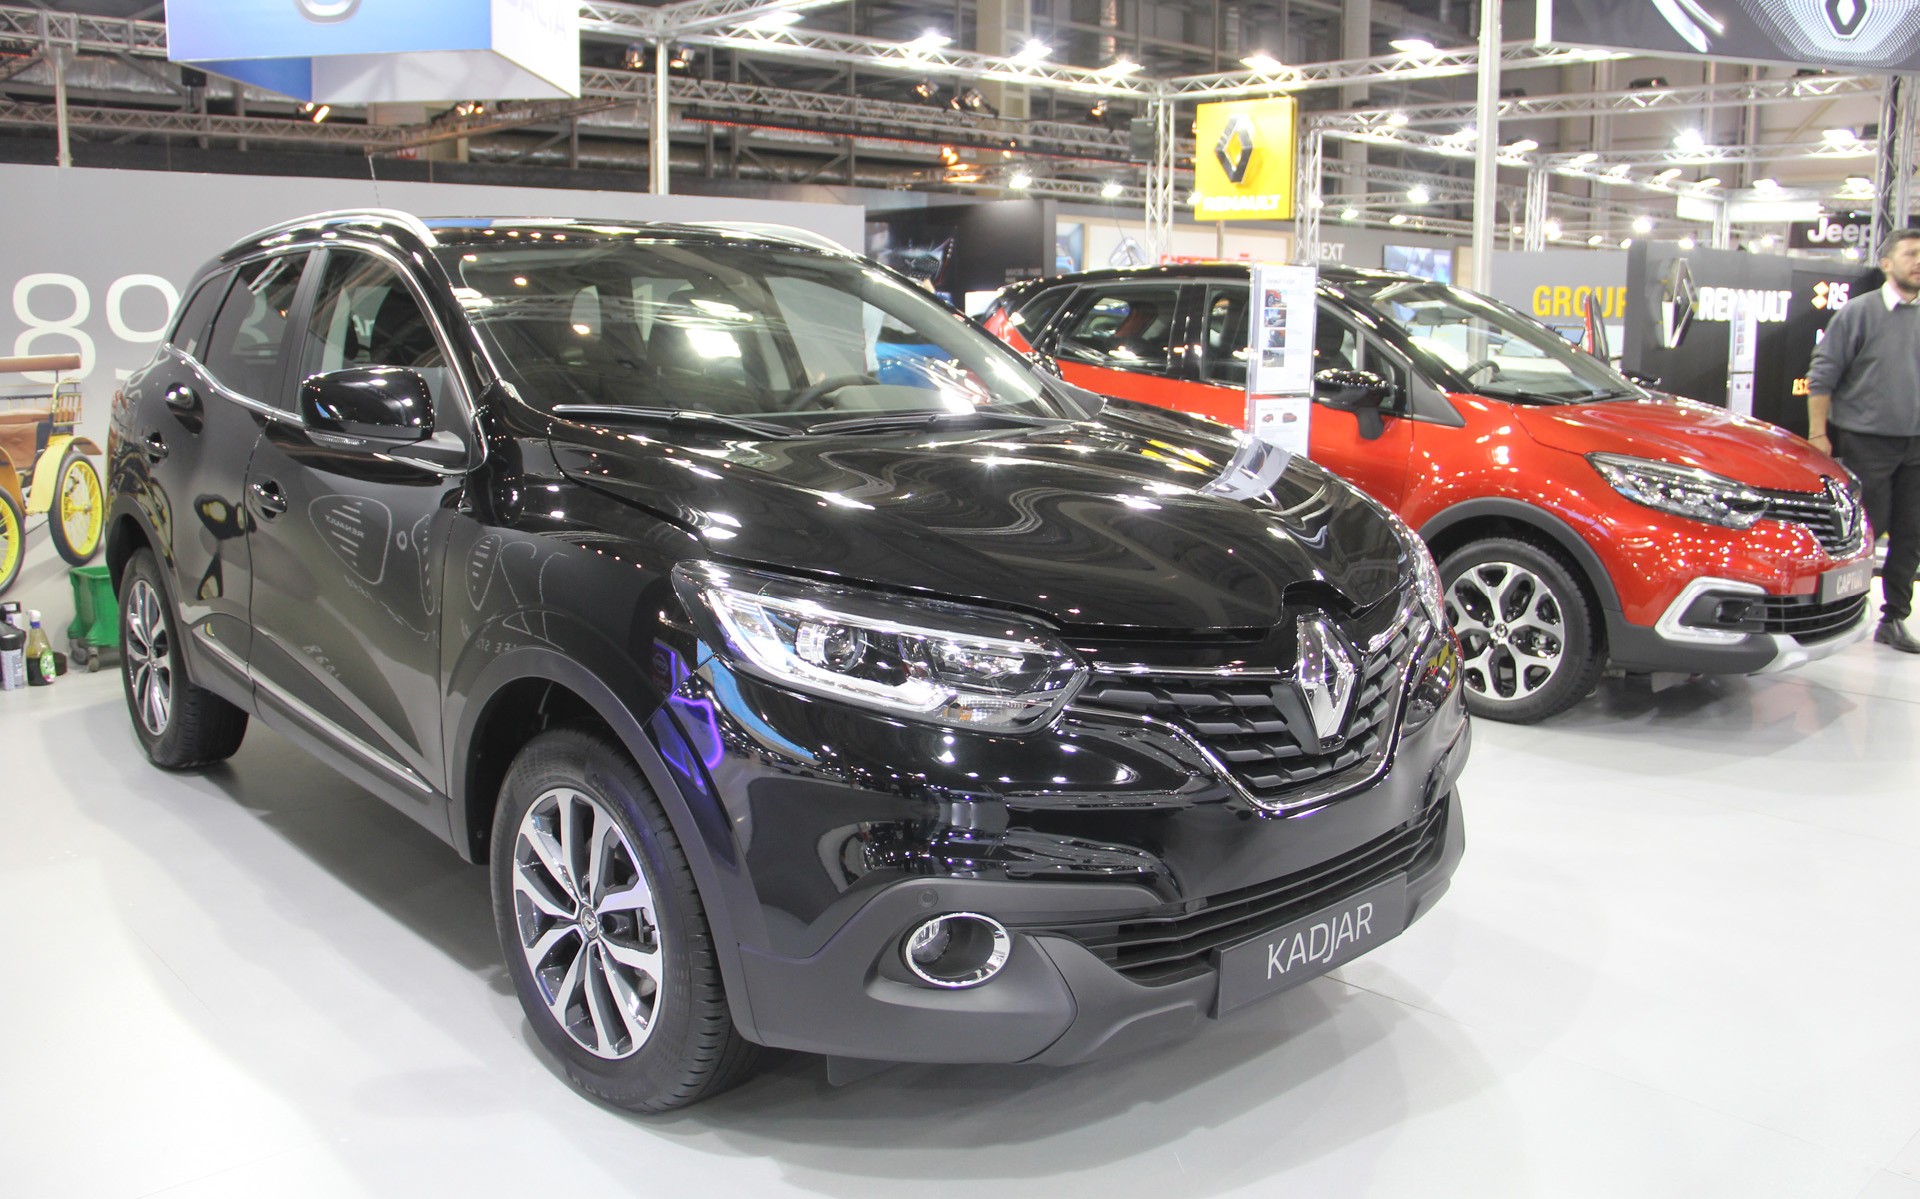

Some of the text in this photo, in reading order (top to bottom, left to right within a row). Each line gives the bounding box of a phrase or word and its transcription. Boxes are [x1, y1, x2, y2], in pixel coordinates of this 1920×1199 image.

[1203, 194, 1281, 211] RENAULT
[1807, 217, 1872, 246] Jeep
[1836, 569, 1863, 595] CAPTUR
[1267, 902, 1373, 980] KADJAR
